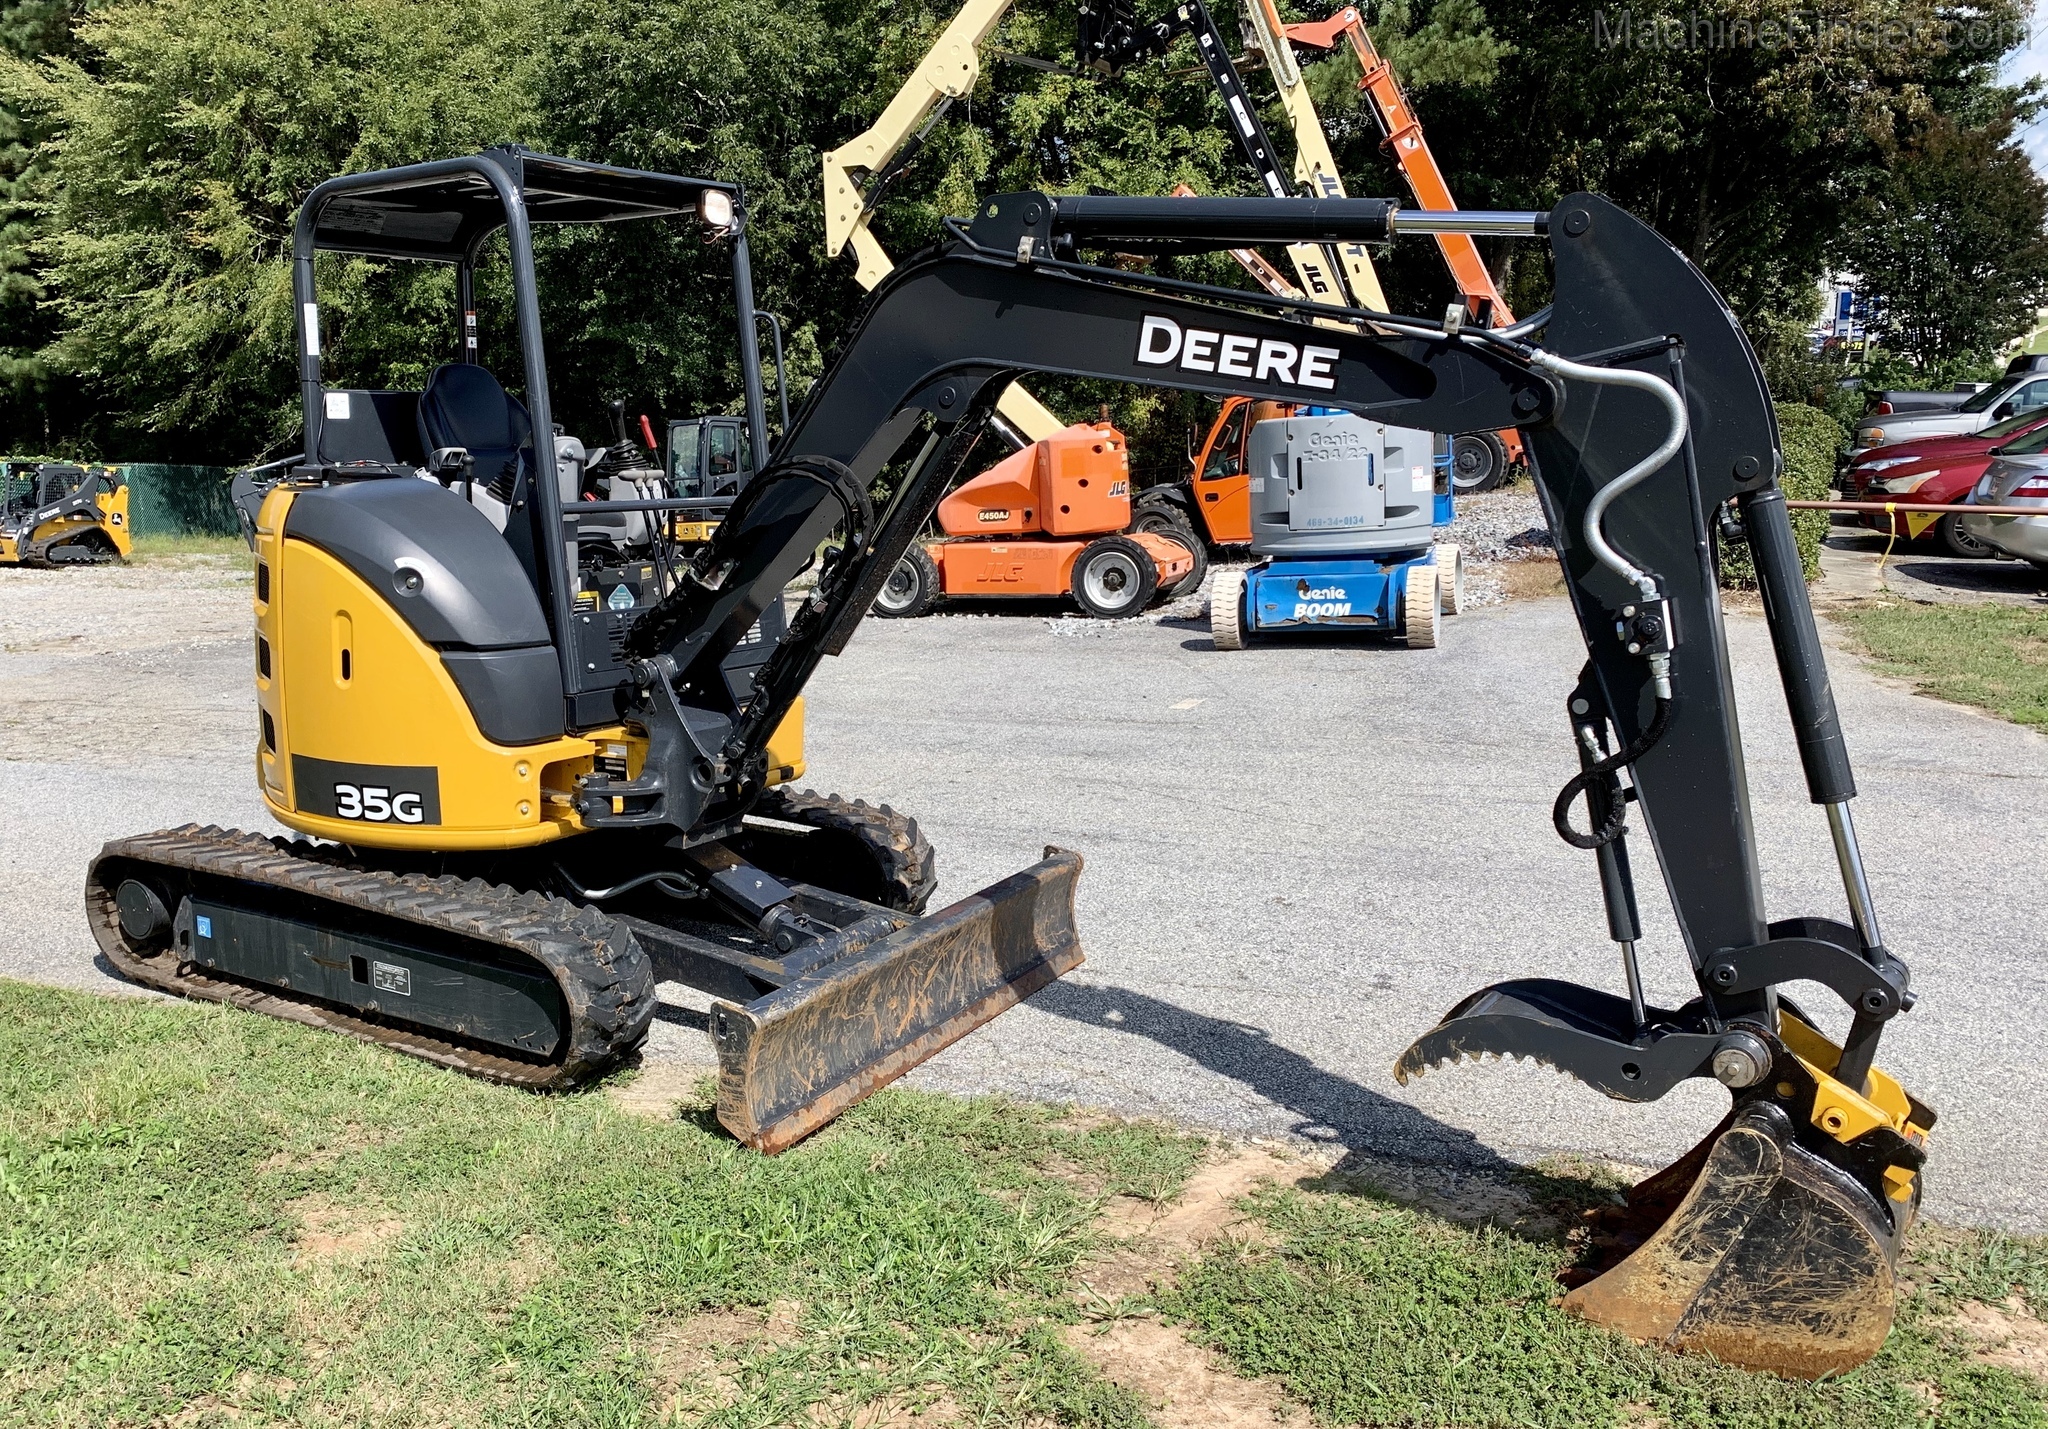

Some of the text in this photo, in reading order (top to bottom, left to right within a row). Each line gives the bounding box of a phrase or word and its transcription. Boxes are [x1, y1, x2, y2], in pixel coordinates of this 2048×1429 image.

[1220, 73, 1229, 84] B
[1239, 111, 1247, 120] C
[1255, 148, 1265, 159] D
[1274, 187, 1282, 197] E
[1301, 263, 1329, 294] JLG
[1137, 315, 1341, 390] DEERE
[1308, 431, 1359, 448] Genie
[1109, 481, 1126, 497] JLG
[39, 507, 61, 520] DEERE
[979, 511, 1009, 520] E450AJ
[976, 562, 1025, 582] JLG
[1293, 602, 1352, 618] BOOM
[335, 784, 423, 823] 35G
